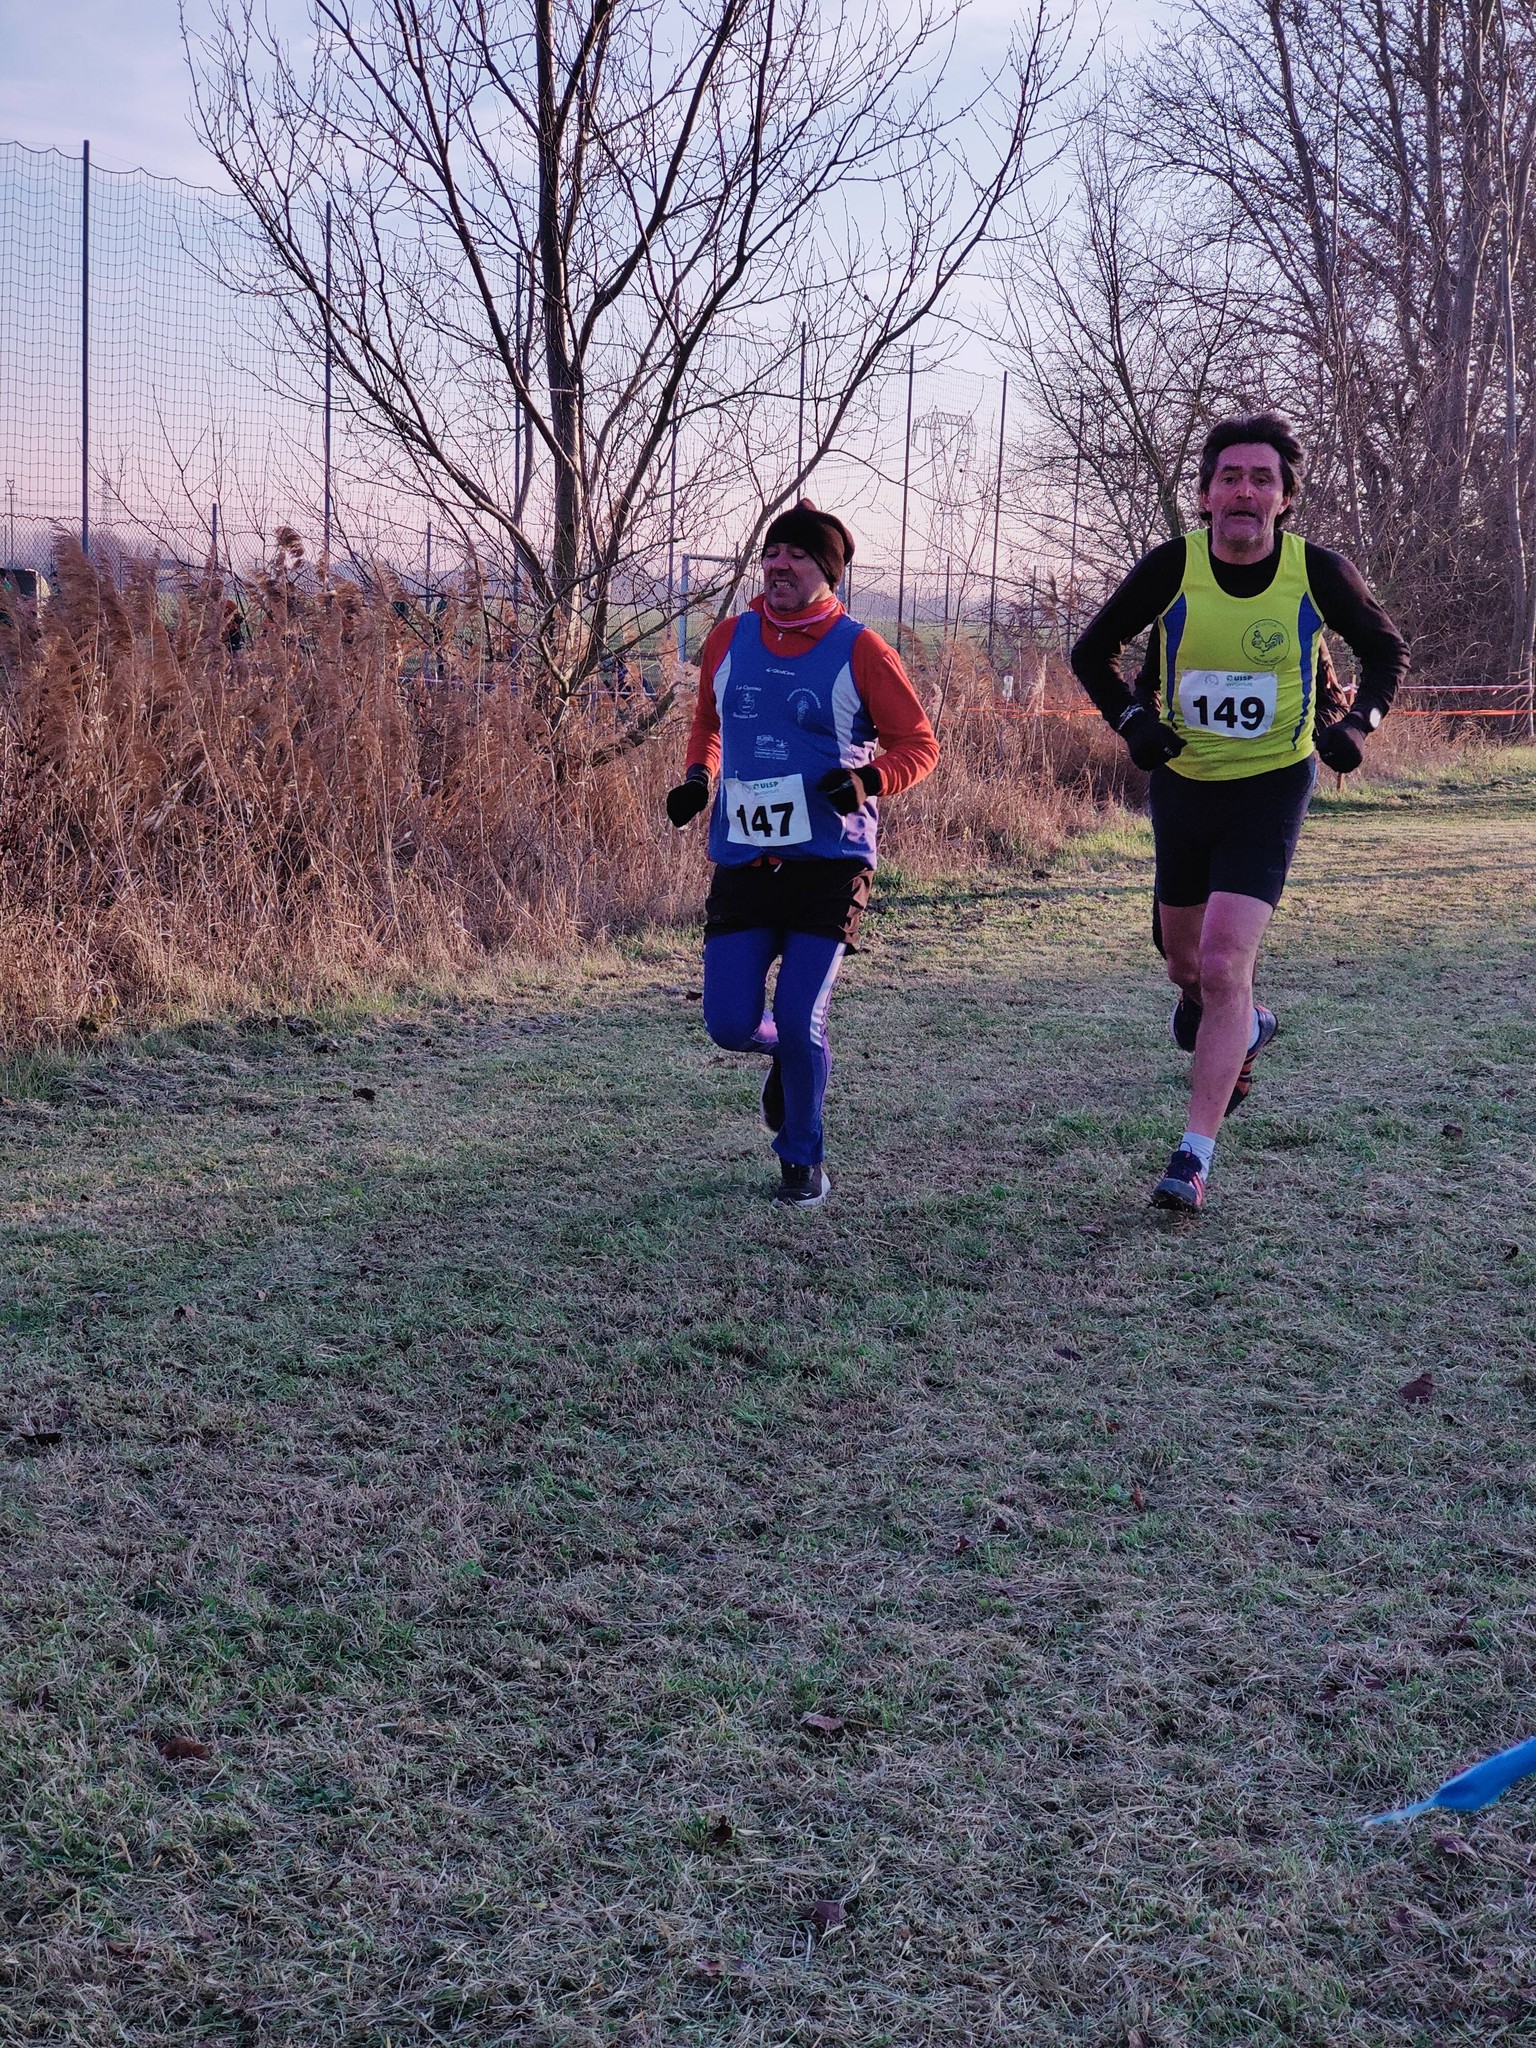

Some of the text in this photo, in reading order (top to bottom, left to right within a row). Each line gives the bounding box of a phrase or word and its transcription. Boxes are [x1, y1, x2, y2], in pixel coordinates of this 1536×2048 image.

[1192, 695, 1266, 731] 149
[760, 781, 779, 789] UISP
[736, 801, 795, 838] 147
